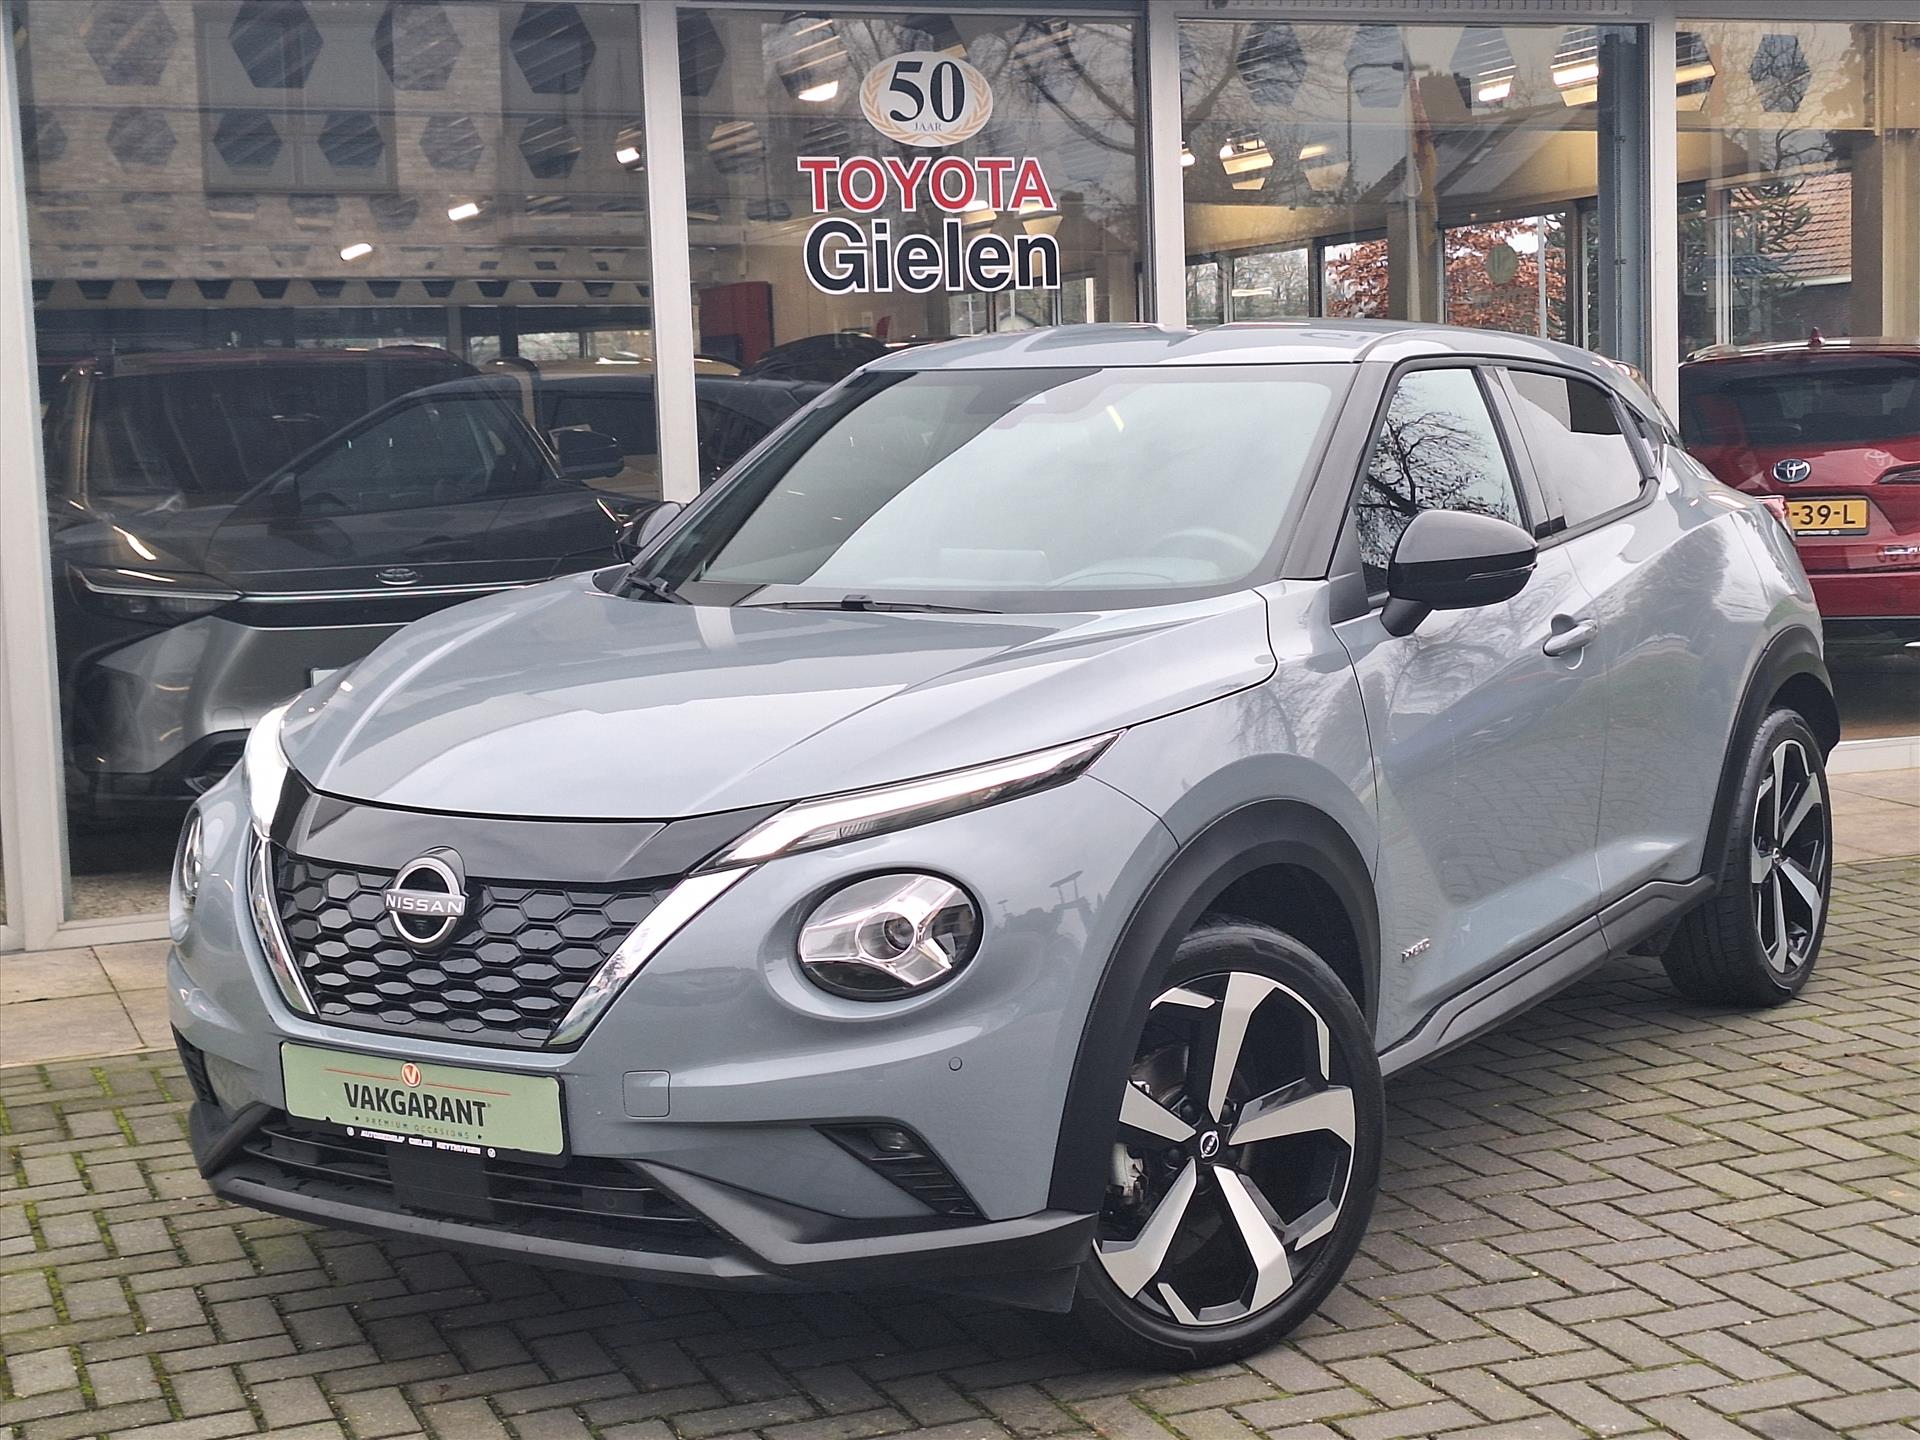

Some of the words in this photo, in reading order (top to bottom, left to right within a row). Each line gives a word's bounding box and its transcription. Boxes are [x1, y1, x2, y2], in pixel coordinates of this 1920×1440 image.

[889, 60, 966, 123] 50
[913, 121, 943, 132] JAAR
[798, 156, 1057, 213] TOYOTA
[803, 217, 1061, 295] Gielen
[385, 893, 463, 914] NISSAN
[343, 1081, 487, 1127] VAKGARANT
[365, 1116, 408, 1130] PREMIUM
[414, 1124, 470, 1140] OCCASIONS
